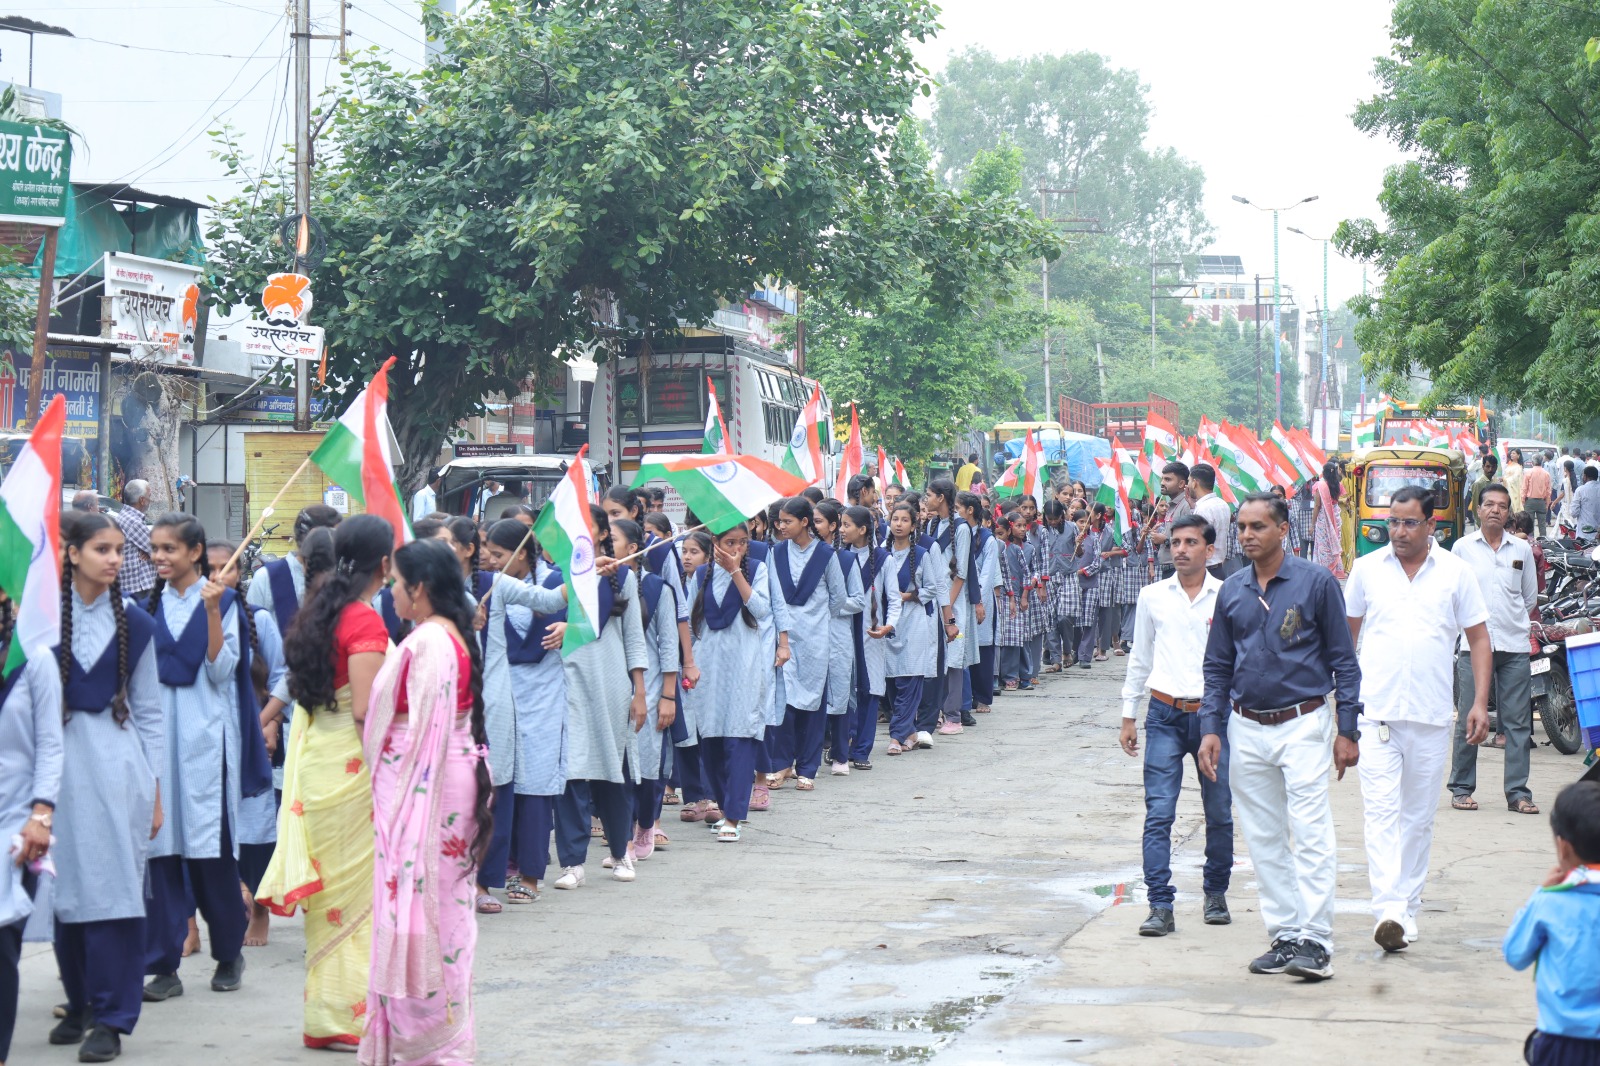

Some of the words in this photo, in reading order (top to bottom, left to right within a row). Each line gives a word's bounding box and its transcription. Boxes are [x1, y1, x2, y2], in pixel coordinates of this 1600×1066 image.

[26, 126, 65, 180] केन्द्र
[246, 326, 316, 344] उपसरपंच
[58, 362, 100, 392] नामली
